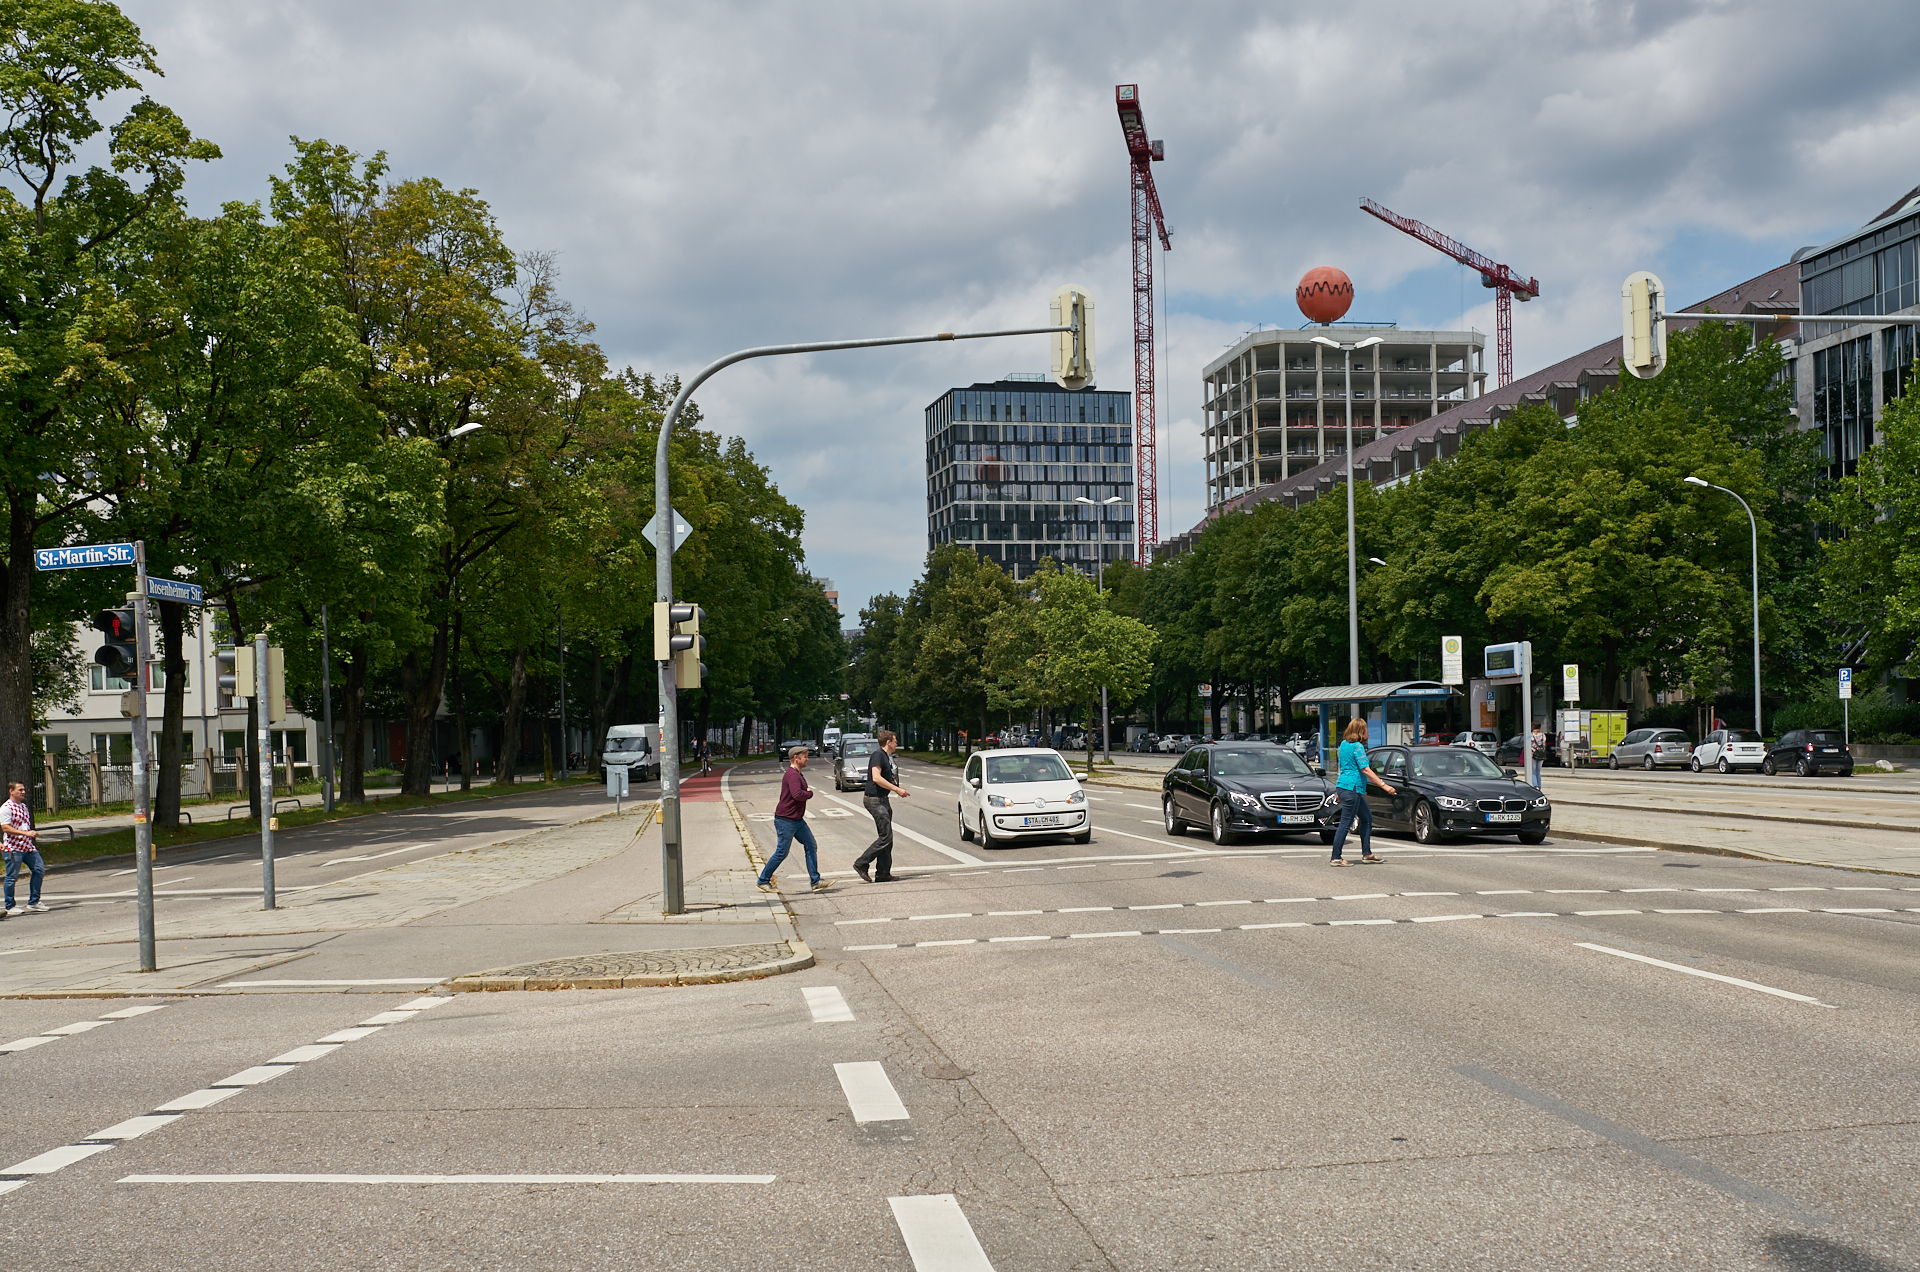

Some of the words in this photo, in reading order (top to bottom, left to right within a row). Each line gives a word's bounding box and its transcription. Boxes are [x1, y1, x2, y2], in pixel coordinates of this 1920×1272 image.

[39, 546, 132, 567] St.-Martin-Str.
[1145, 545, 1149, 553] 1
[149, 578, 190, 600] Rosenheimer
[190, 586, 202, 601] Str.
[1840, 670, 1848, 681] P
